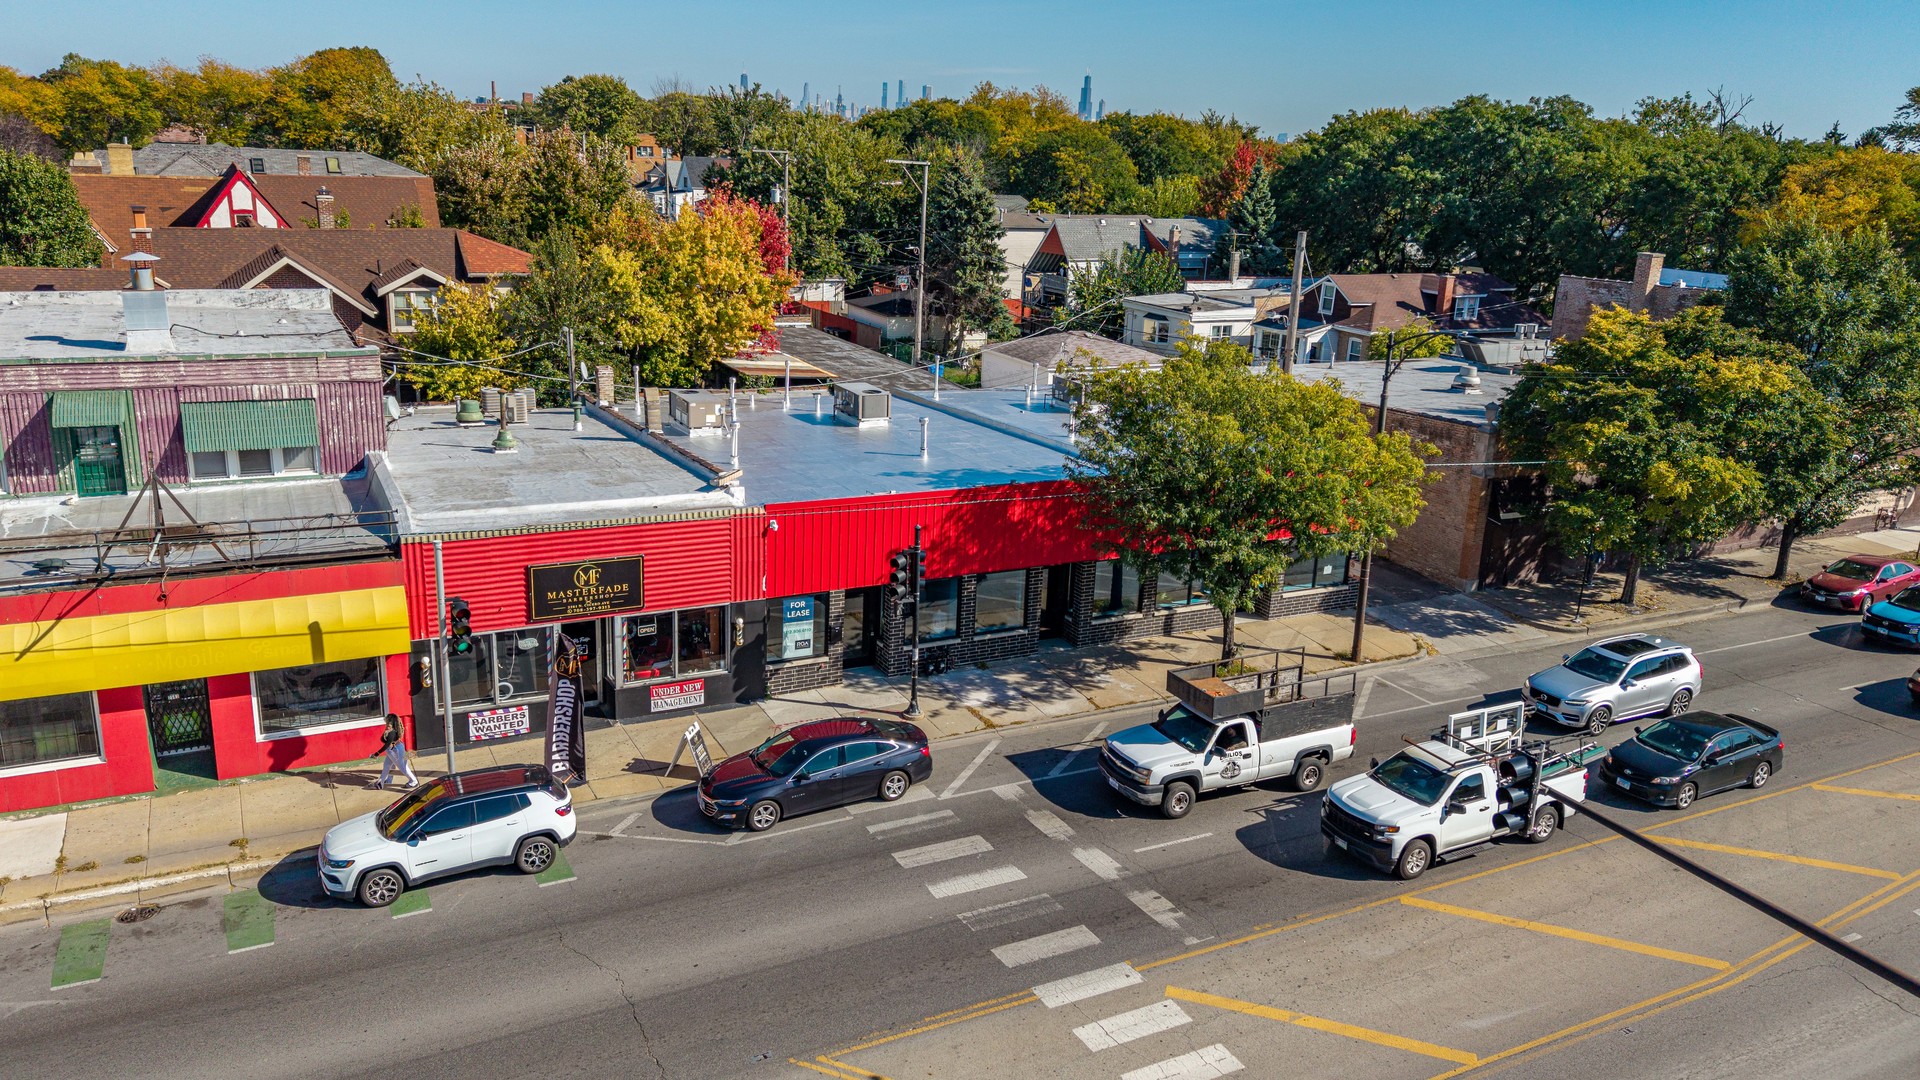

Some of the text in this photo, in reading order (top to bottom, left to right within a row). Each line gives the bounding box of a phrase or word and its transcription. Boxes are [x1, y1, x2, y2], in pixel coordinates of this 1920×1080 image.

[547, 584, 629, 599] MASTERFADE
[562, 594, 614, 603] BARBERSHOP
[790, 600, 806, 609] FOR
[787, 609, 811, 618] LEASE
[639, 626, 655, 634] OPEN
[652, 682, 703, 697] UNDER NEW
[652, 694, 703, 710] MANAGEMENT
[471, 711, 526, 726] BARBERS
[474, 720, 524, 733] WANTED
[551, 679, 576, 773] BARBERSHOP
